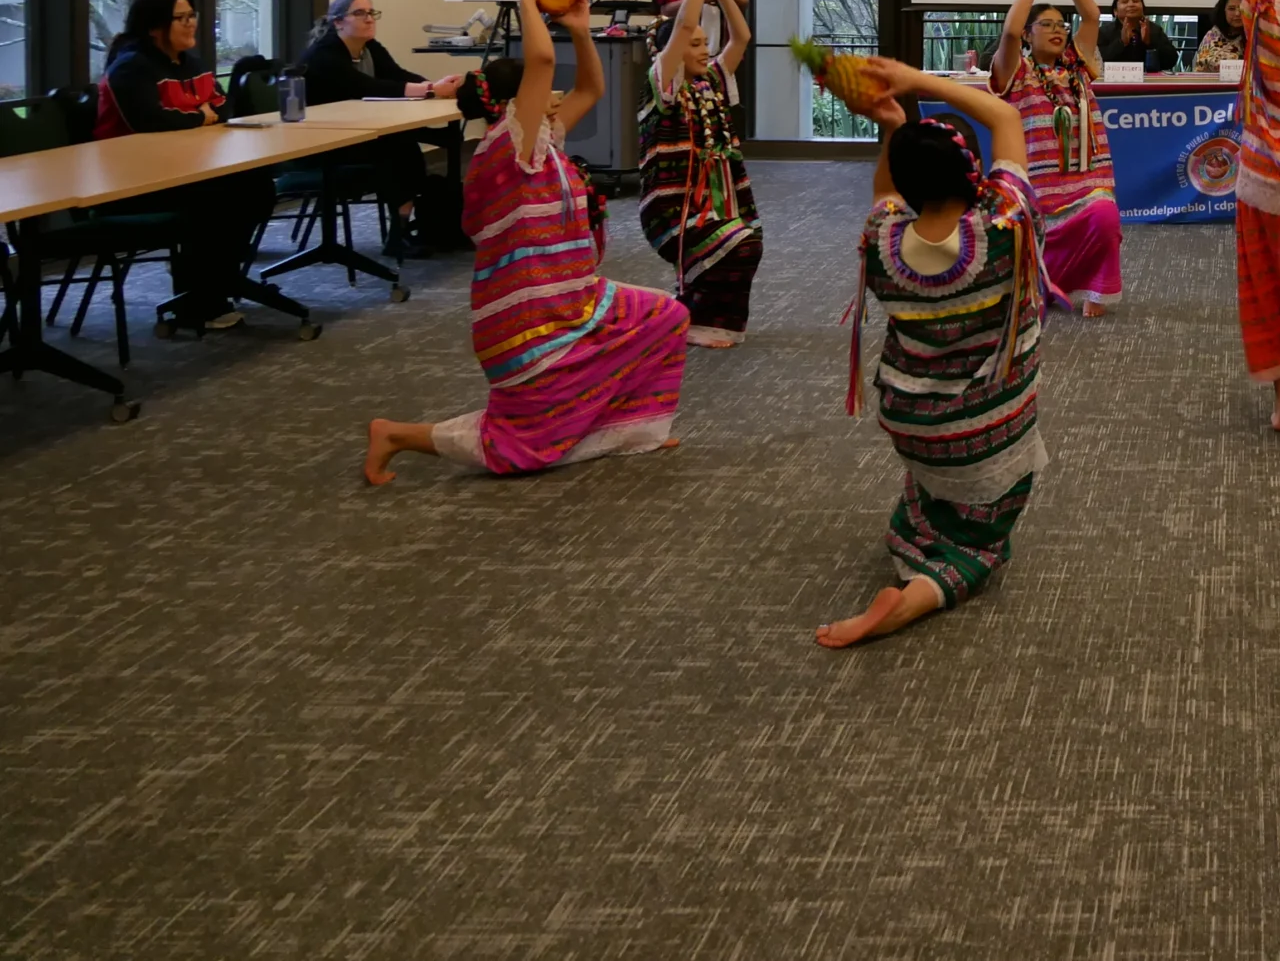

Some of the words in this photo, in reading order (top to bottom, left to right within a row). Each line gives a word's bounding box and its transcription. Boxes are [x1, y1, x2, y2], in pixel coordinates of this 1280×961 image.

[1103, 109, 1187, 129] Centro
[1194, 103, 1234, 126] Del
[1186, 132, 1209, 150] PUEBLO
[1178, 151, 1189, 163] DEL
[1176, 164, 1188, 188] CENTRO
[1119, 203, 1206, 217] entrodelpueblo
